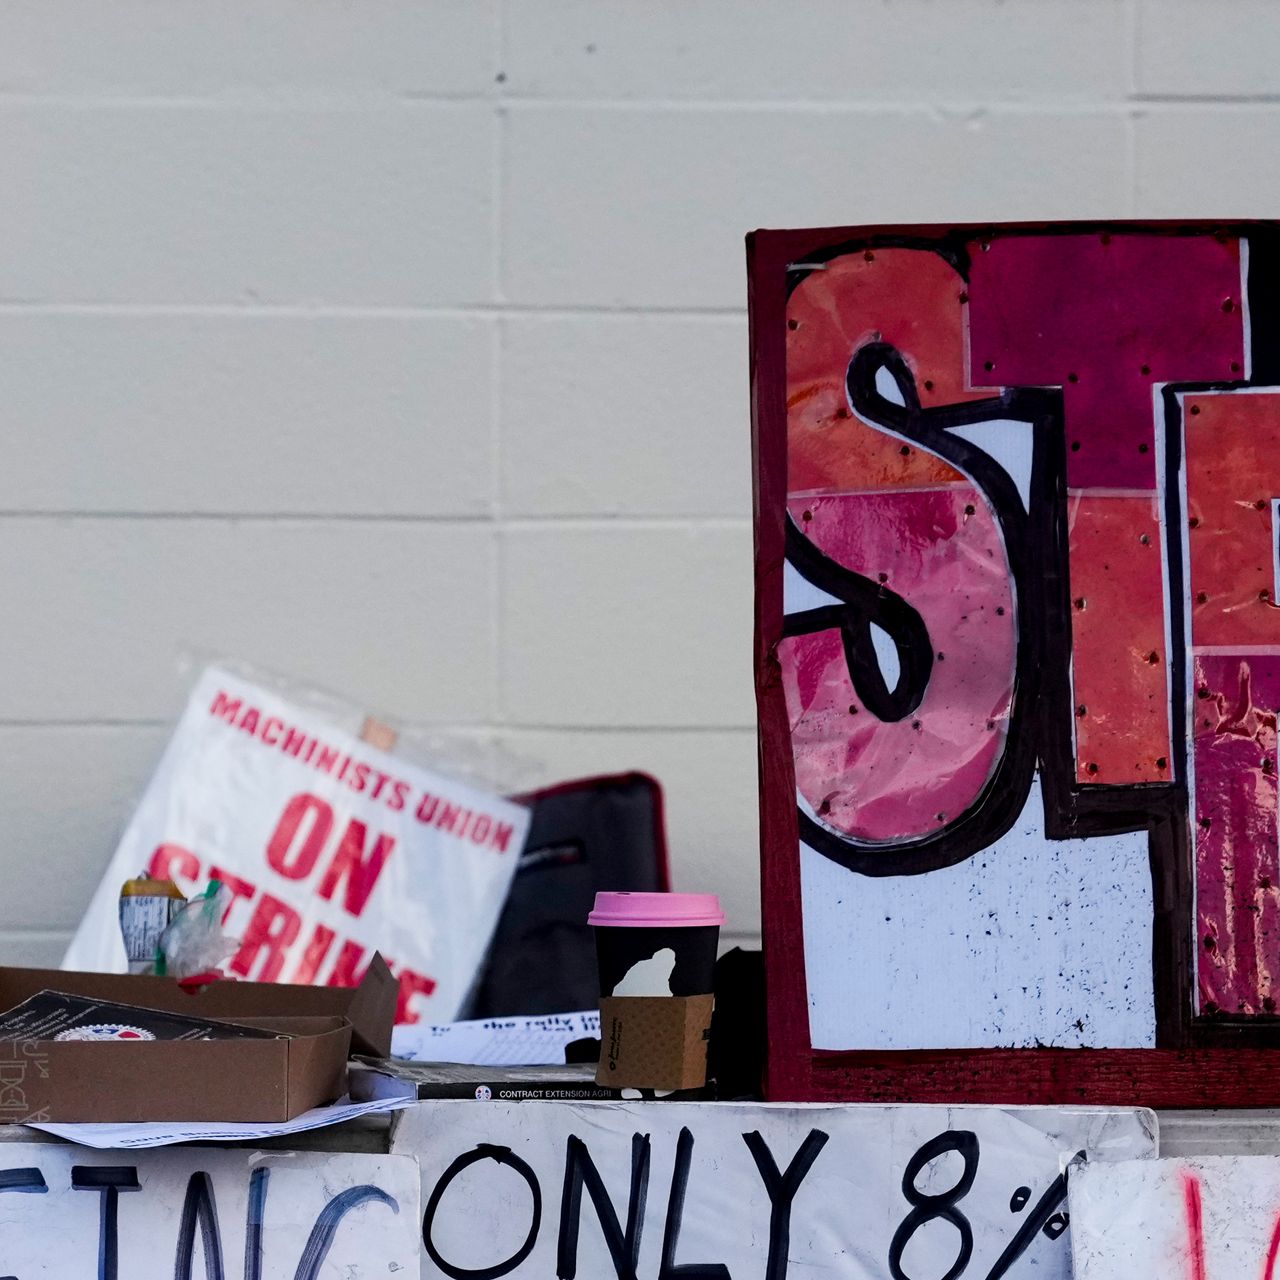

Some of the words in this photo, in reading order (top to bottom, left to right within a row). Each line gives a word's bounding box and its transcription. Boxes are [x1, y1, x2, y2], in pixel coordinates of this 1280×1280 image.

[210, 690, 411, 813] MACHINISTS
[415, 789, 515, 855] UNION
[266, 792, 397, 919] ON
[499, 1090, 543, 1098] CONTRACT
[545, 1089, 591, 1098] EXTENSION
